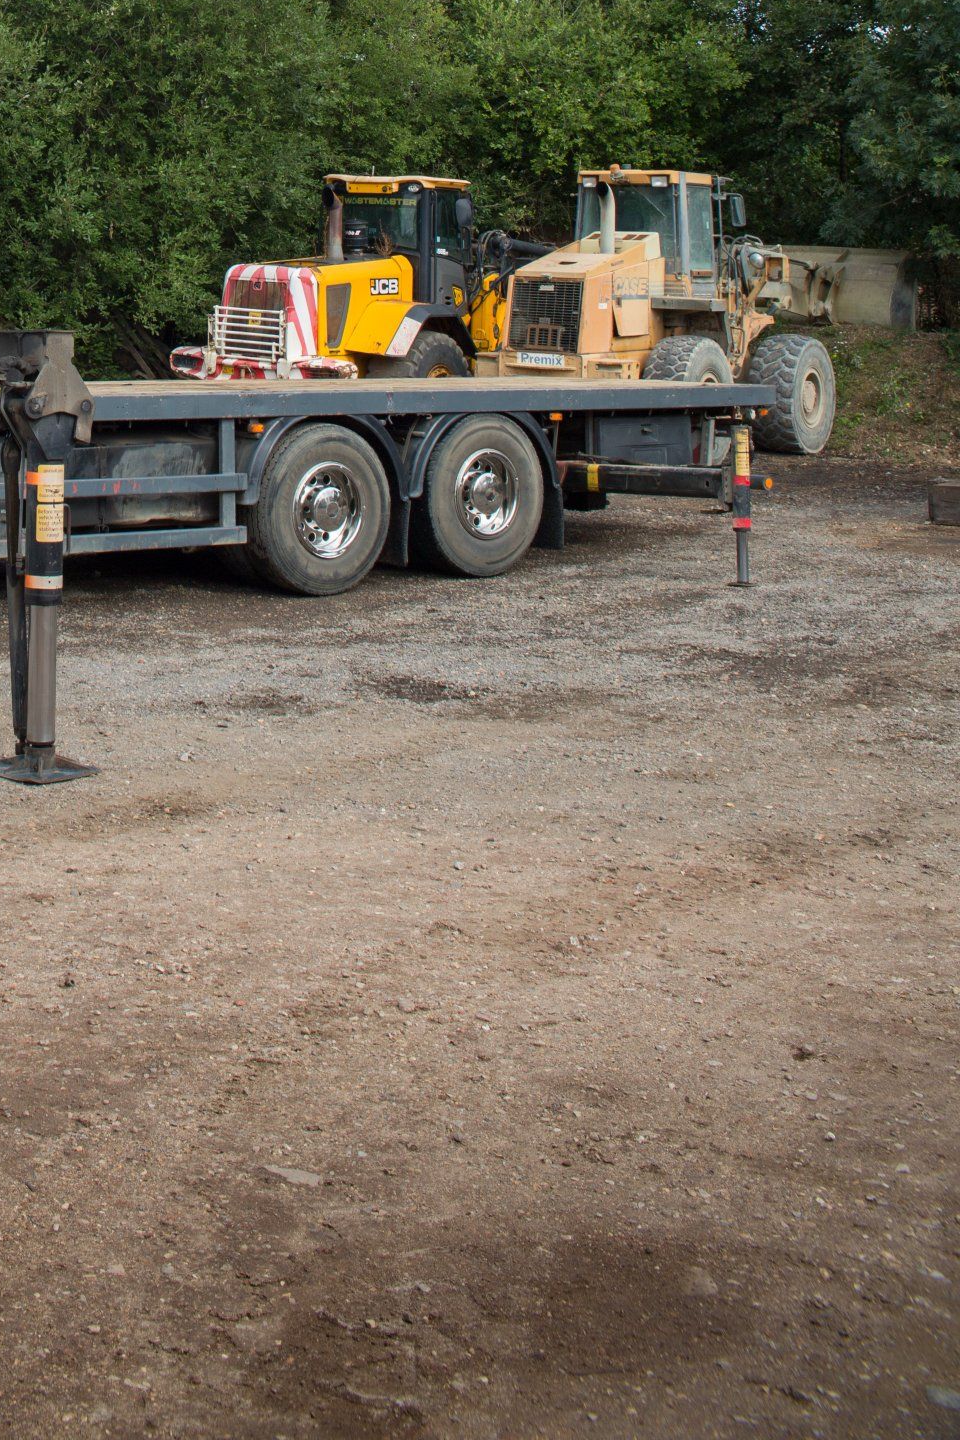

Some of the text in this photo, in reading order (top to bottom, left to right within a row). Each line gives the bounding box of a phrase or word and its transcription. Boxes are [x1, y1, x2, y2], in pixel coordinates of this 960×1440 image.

[370, 278, 399, 295] JCB
[614, 277, 649, 296] CASE
[520, 352, 563, 366] Premix
